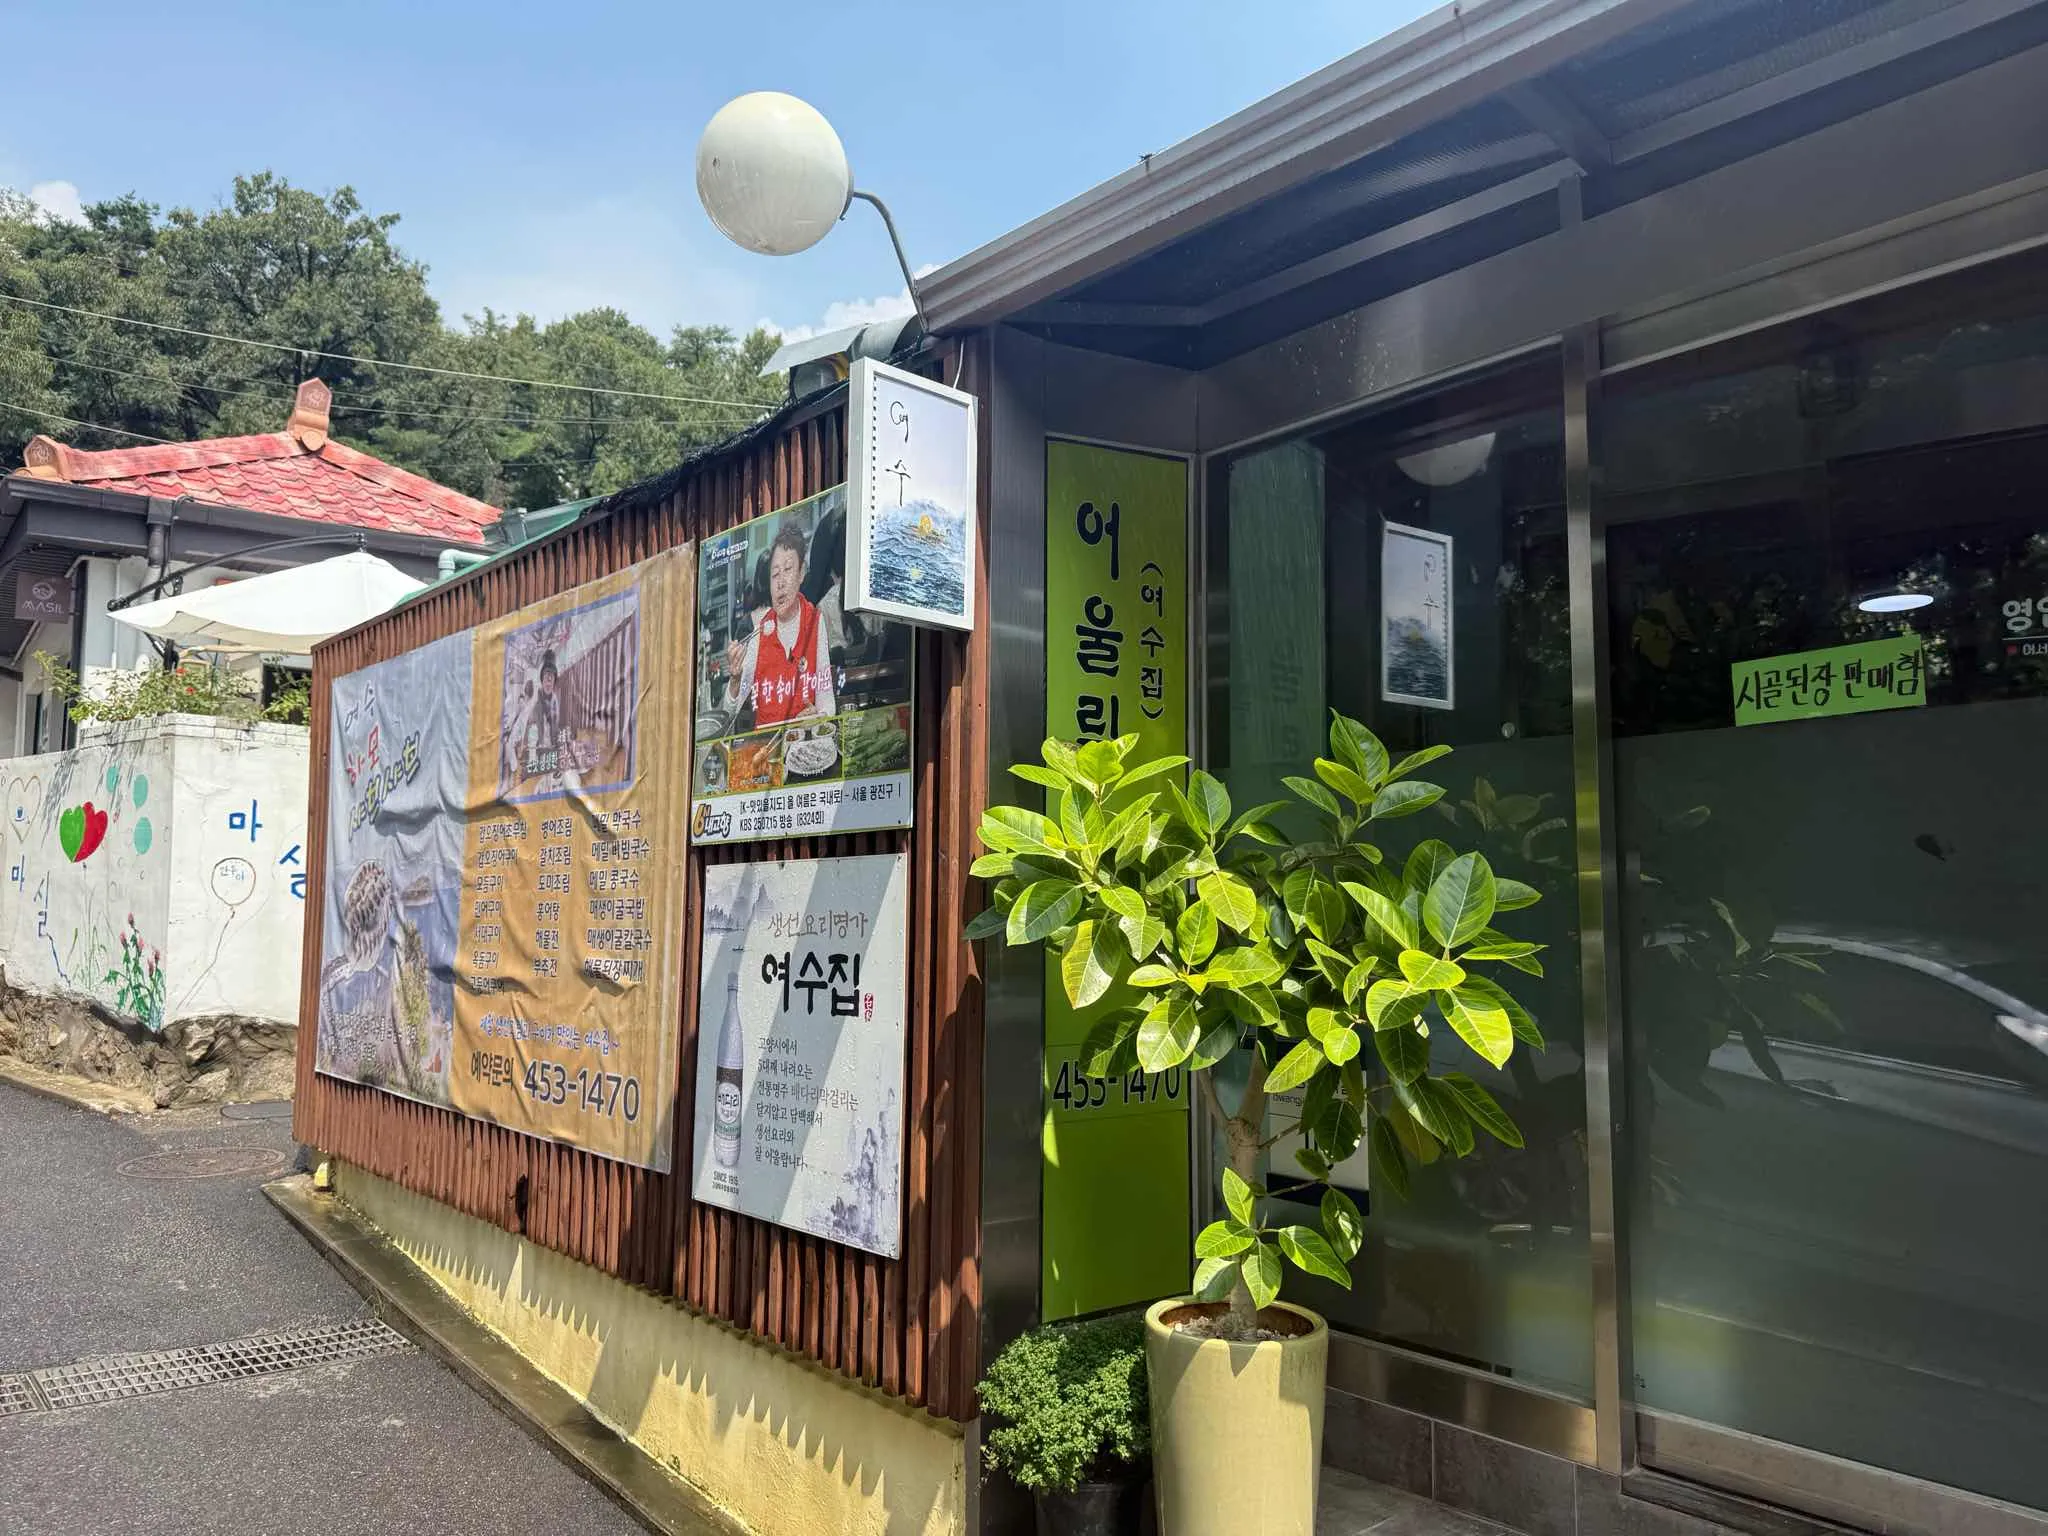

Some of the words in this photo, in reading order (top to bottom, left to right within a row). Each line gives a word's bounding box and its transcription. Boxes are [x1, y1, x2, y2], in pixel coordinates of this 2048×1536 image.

[22, 600, 65, 615] MASIL
[1735, 661, 1838, 710] 시골된장
[1843, 649, 1924, 699] 판매함
[796, 792, 817, 808] 여름은
[852, 786, 867, 803] 서울
[870, 783, 894, 801] 광진구
[541, 817, 573, 839] 병어조림
[612, 809, 641, 832] 막국수
[739, 816, 753, 832] KBS
[779, 812, 793, 829] 방송
[539, 846, 571, 867] 갈치조림
[591, 840, 609, 862] 메밀
[538, 874, 570, 893] 도미조림
[589, 870, 608, 891] 메밀
[609, 868, 640, 890] 콩국수
[536, 902, 560, 921] 홍어탕
[589, 898, 645, 920] 매생이굴국밥
[767, 909, 869, 939] 생선요리명가
[535, 929, 560, 950] 해물전
[587, 928, 653, 950] 매생이굴칼국수
[533, 958, 559, 977] 부추전
[761, 951, 861, 1017] 여수집
[758, 1037, 798, 1056] 고양시에서
[780, 1060, 813, 1081] 내려오는
[470, 1049, 515, 1089] 예약문의
[523, 1059, 641, 1122] 453-1470
[758, 1080, 789, 1100] 전통명주
[756, 1101, 788, 1121] 달지않고
[790, 1107, 824, 1128] 담백해서
[755, 1122, 794, 1146] 생선요리와
[754, 1144, 763, 1163] 잘
